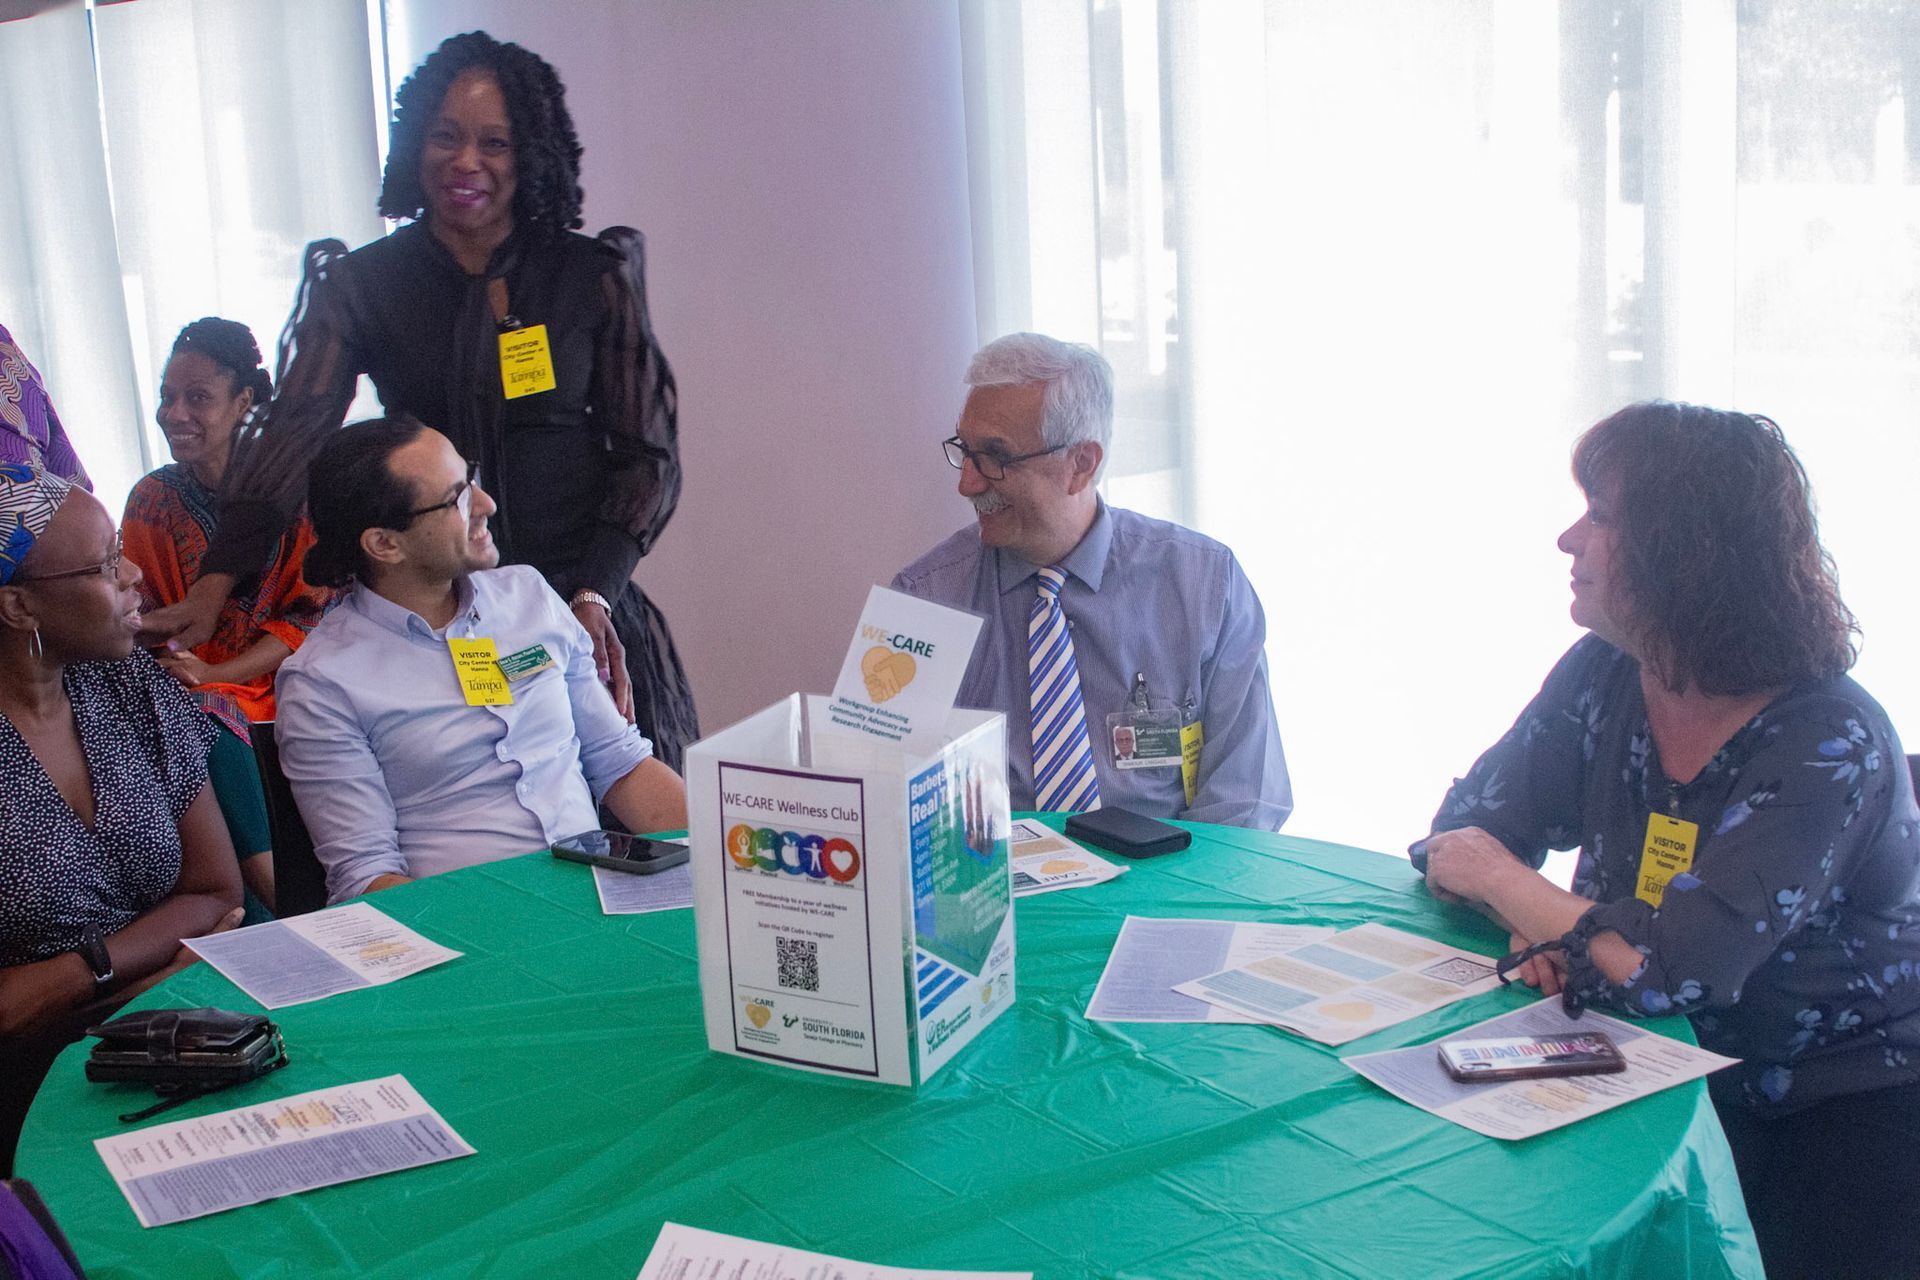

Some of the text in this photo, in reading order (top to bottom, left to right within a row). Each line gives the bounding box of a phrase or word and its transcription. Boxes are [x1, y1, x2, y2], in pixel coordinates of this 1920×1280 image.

[506, 340, 539, 352] VISITOR
[510, 368, 546, 383] Tampa
[862, 624, 936, 658] WE-CARE
[460, 651, 491, 659] VISITOR
[466, 679, 503, 694] Tampa
[829, 704, 912, 735] Community Advocacy and
[839, 697, 909, 725] Workgroup Enhancing
[831, 715, 902, 741] Research Engagement
[724, 792, 859, 822] WE-CARE Wellness Club
[911, 792, 938, 826] Real
[1653, 836, 1687, 852] VISITOR
[1647, 847, 1660, 857] City
[1660, 850, 1680, 861] Center
[1656, 859, 1675, 870] Hanna
[742, 889, 755, 897] FREE
[756, 891, 789, 903] Membership
[823, 902, 847, 911] wellness
[755, 900, 780, 909] initiatives
[801, 906, 808, 914] by
[758, 921, 834, 939] Scan the QR Code to register
[802, 1022, 866, 1041] SOUTH FLORIDA
[1460, 1038, 1592, 1060] MINNIE
